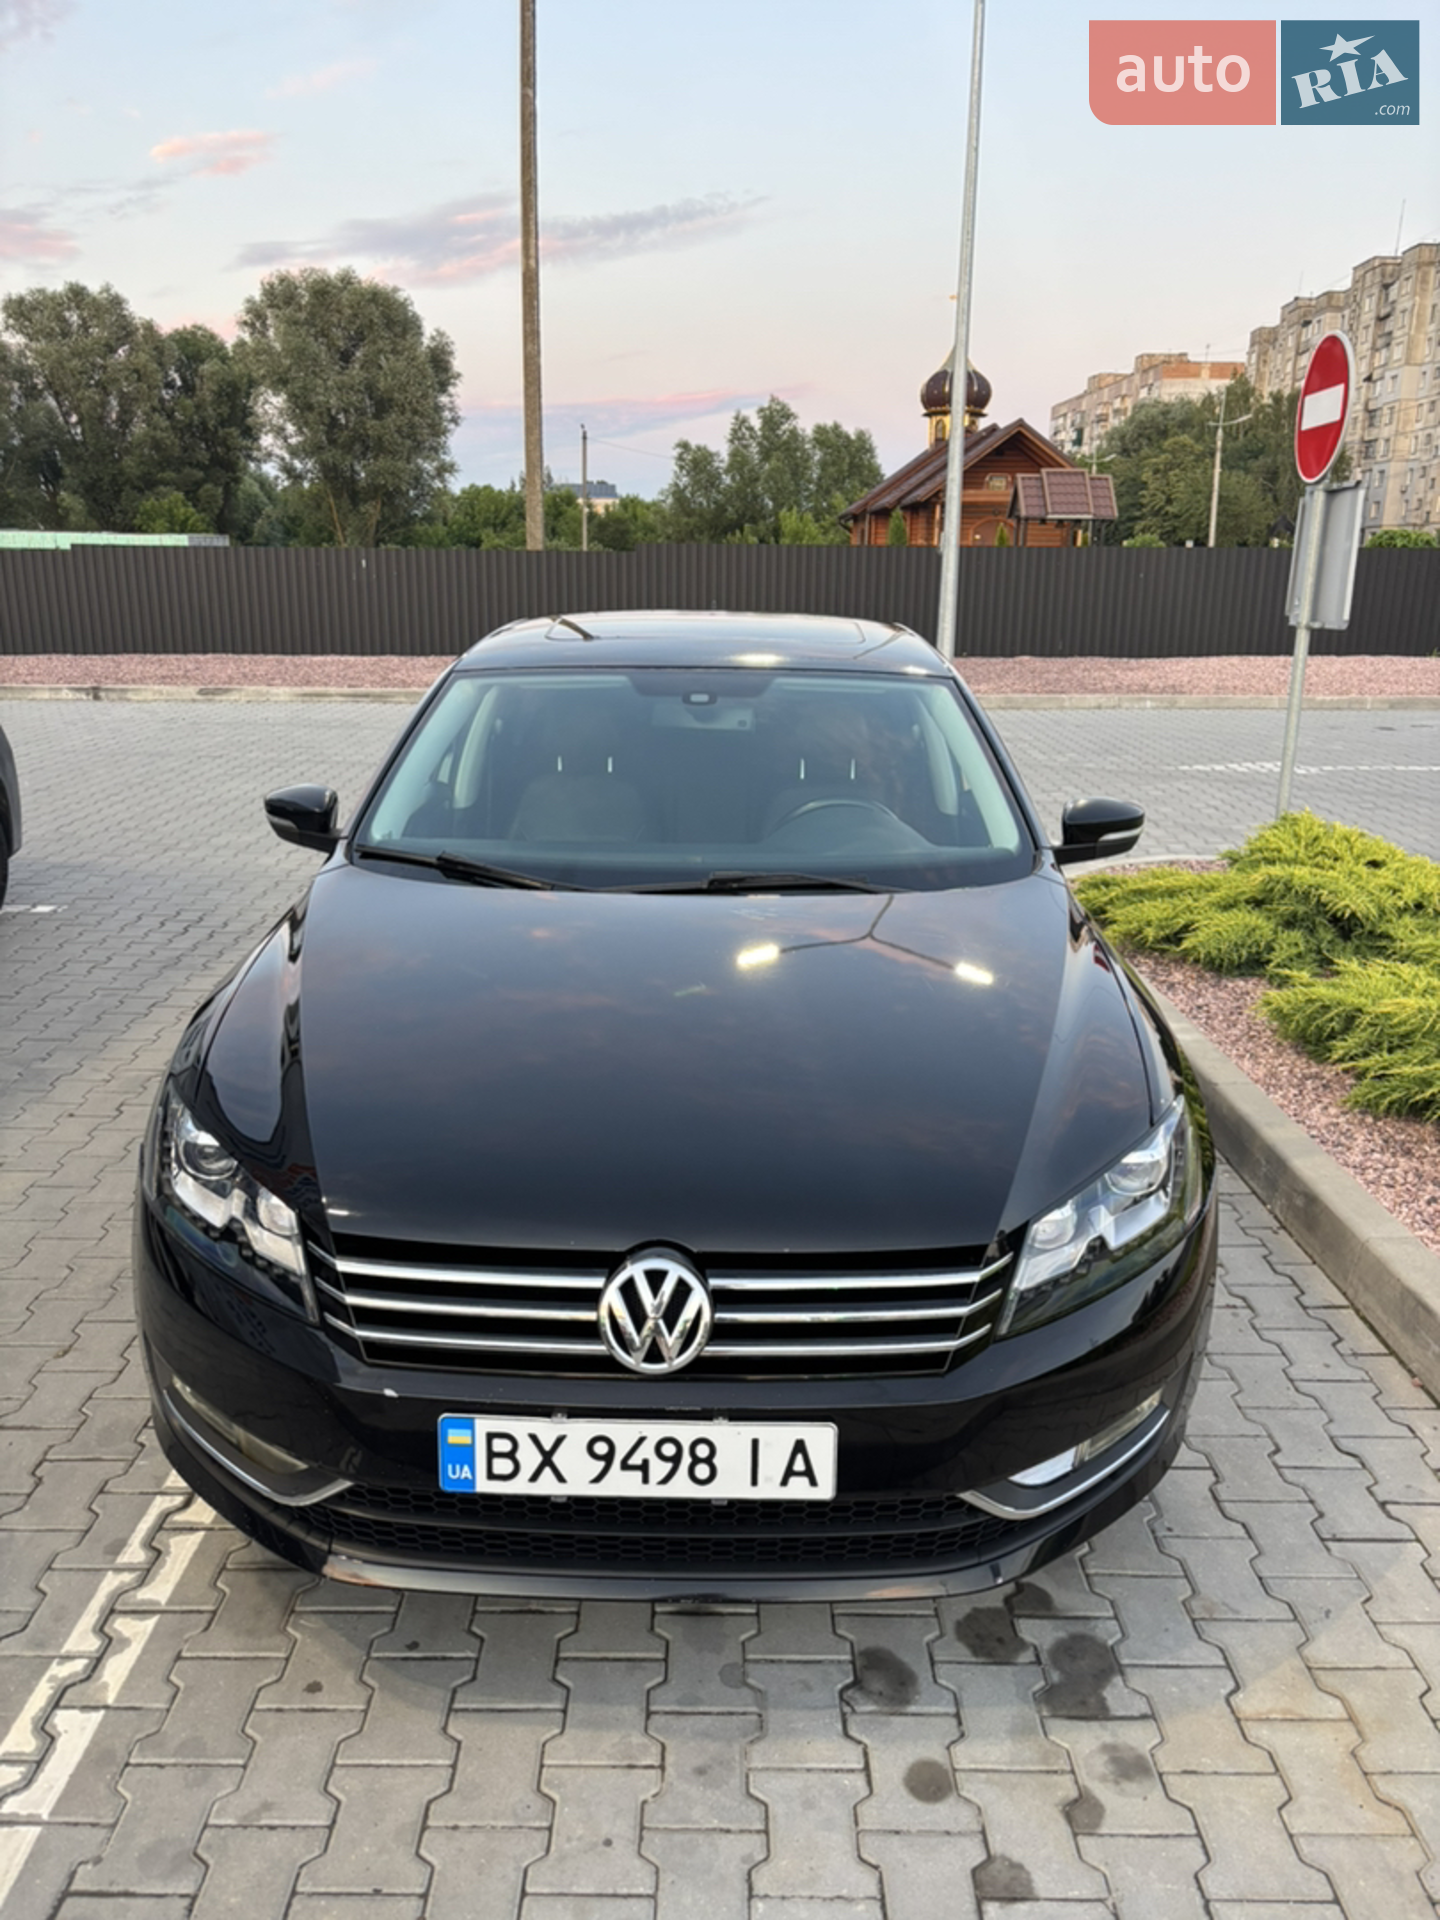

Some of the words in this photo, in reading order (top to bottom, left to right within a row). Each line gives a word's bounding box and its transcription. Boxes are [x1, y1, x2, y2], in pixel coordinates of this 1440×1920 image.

[447, 1463, 473, 1481] UA
[485, 1431, 568, 1484] BX
[586, 1434, 718, 1486] 9498
[750, 1437, 819, 1488] IA
